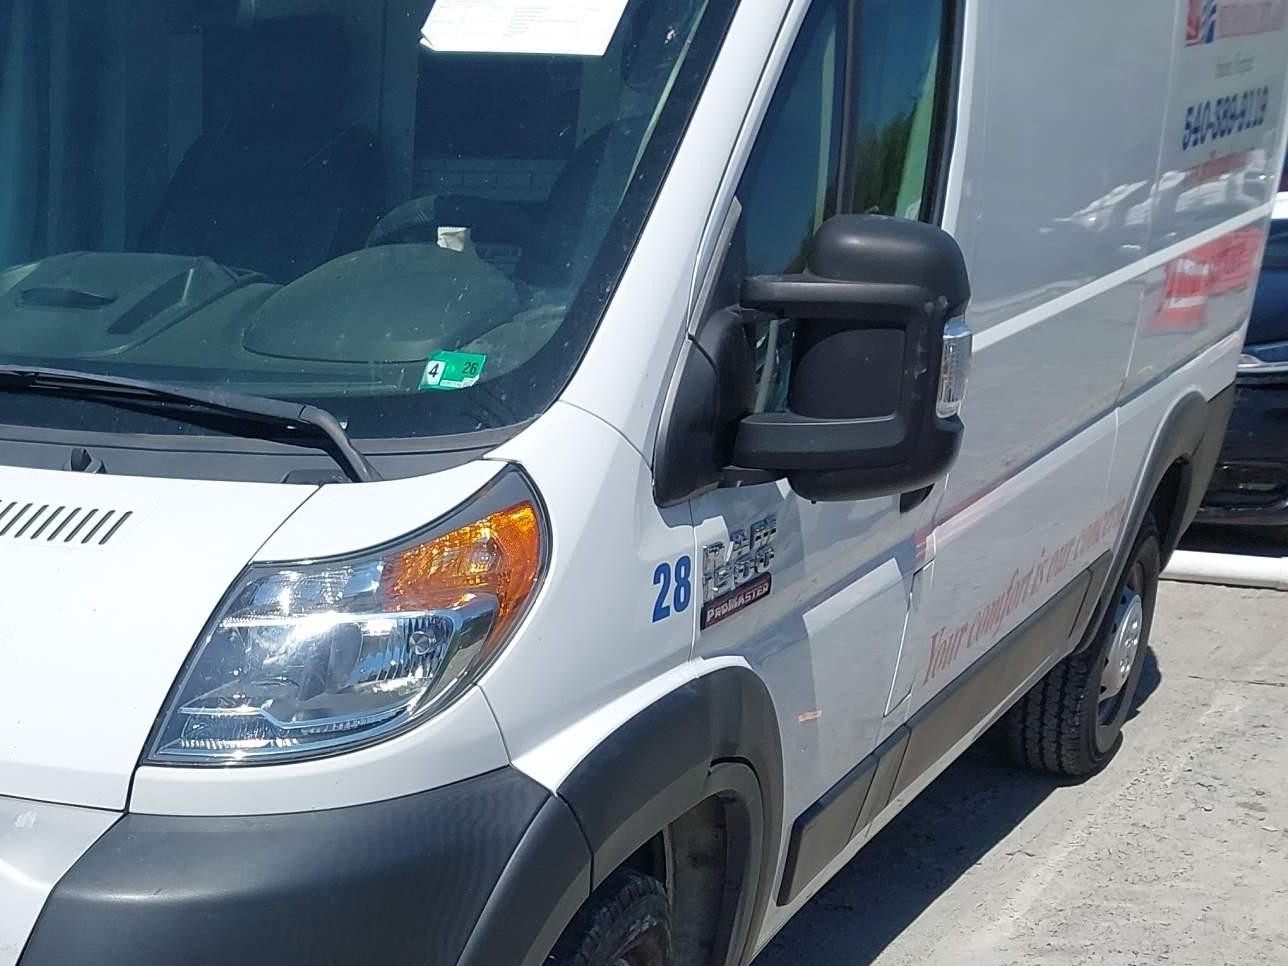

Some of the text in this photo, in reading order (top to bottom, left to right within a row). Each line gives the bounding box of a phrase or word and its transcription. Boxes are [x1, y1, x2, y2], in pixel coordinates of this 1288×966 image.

[428, 361, 478, 378] 4 26
[652, 555, 692, 623] 28
[923, 622, 969, 686] Your
